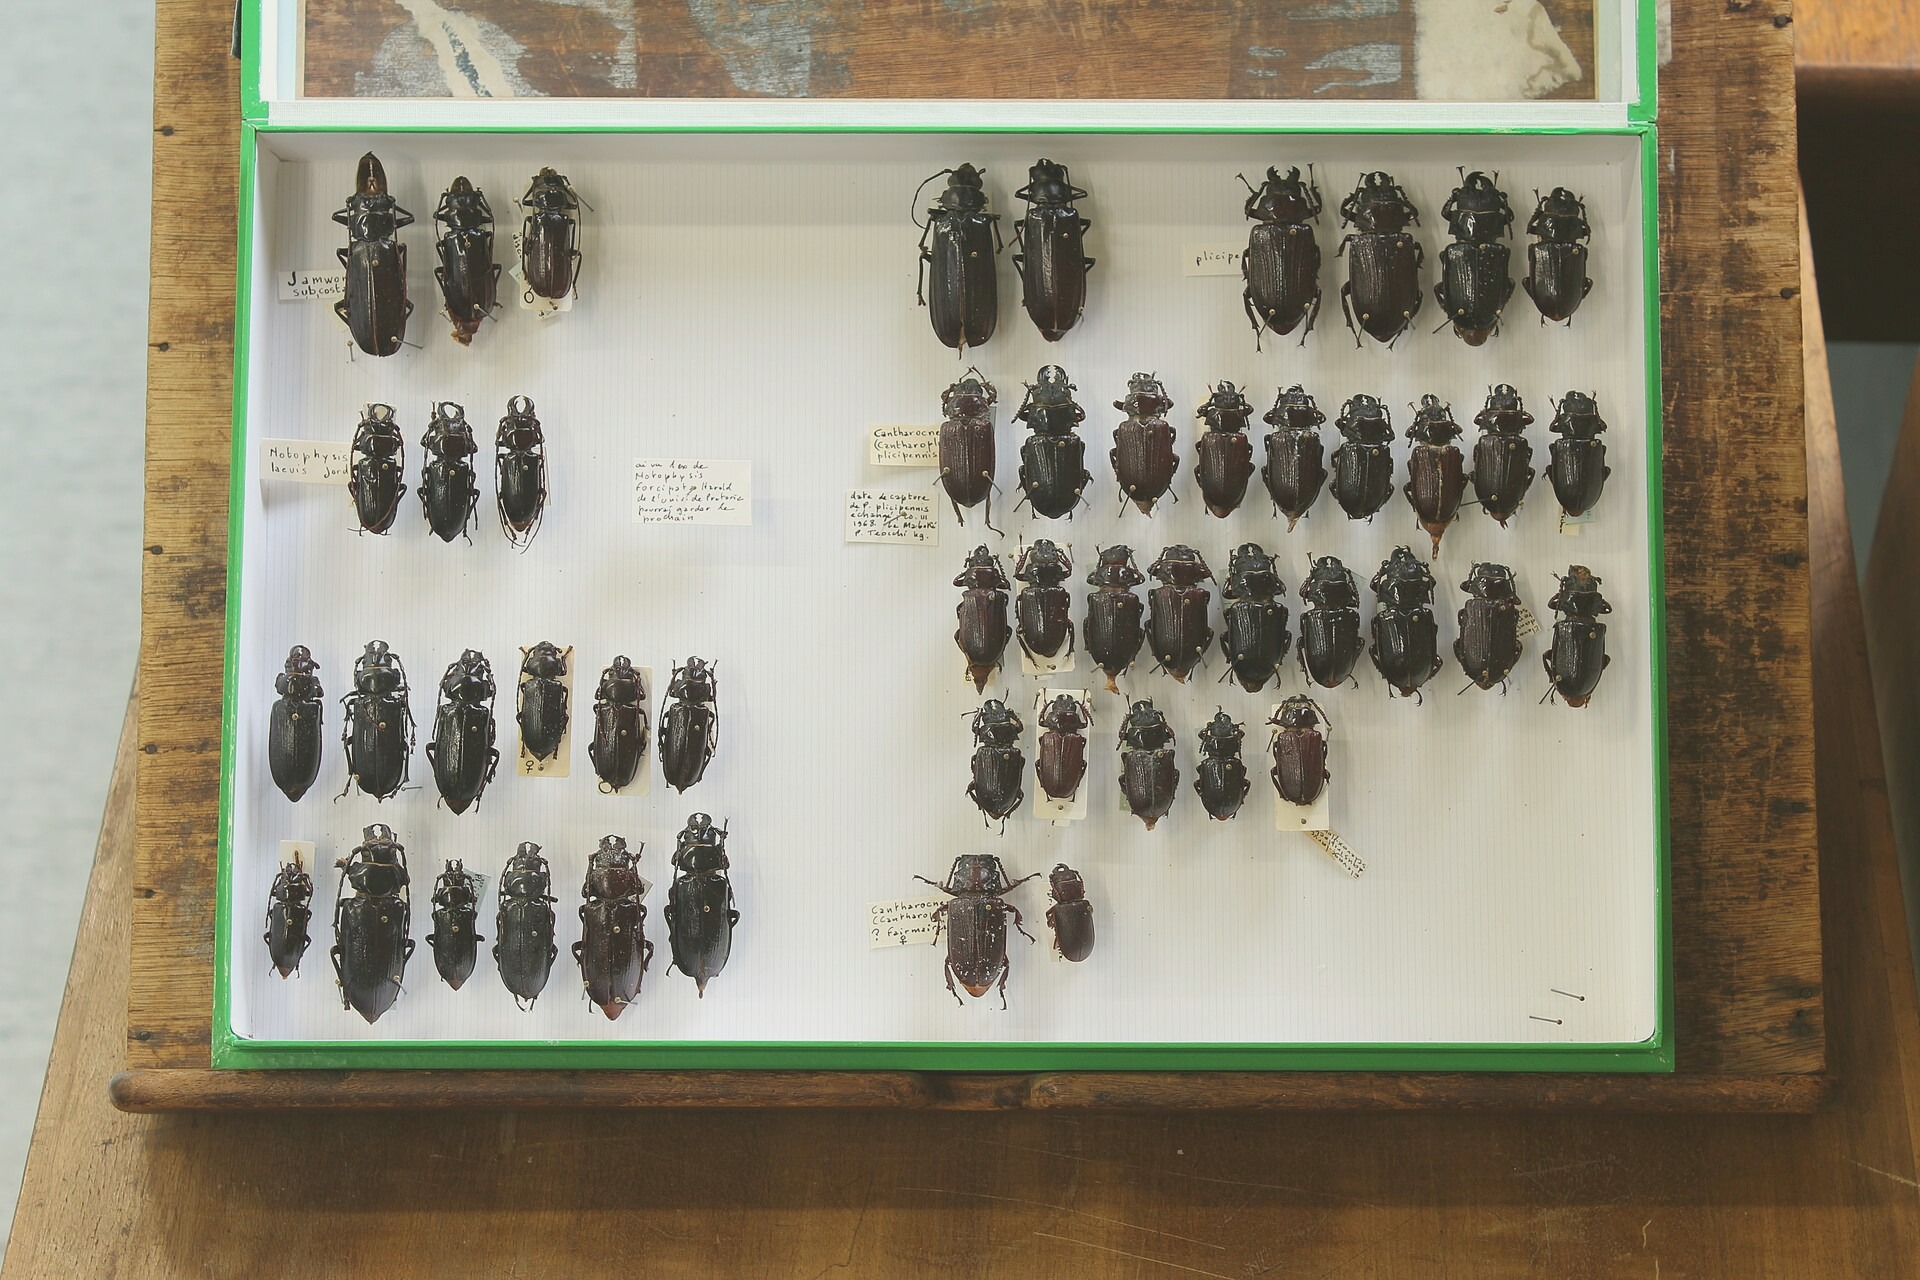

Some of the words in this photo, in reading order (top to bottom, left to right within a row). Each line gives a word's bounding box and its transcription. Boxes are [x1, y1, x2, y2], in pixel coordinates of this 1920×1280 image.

[873, 438, 940, 452] (Cantharopl
[269, 446, 348, 465] Notophysis
[877, 450, 938, 463] plicipennis
[323, 463, 349, 479] Jord
[635, 470, 704, 483] Notophysis
[850, 491, 873, 500] date
[876, 502, 930, 515] plicipennis
